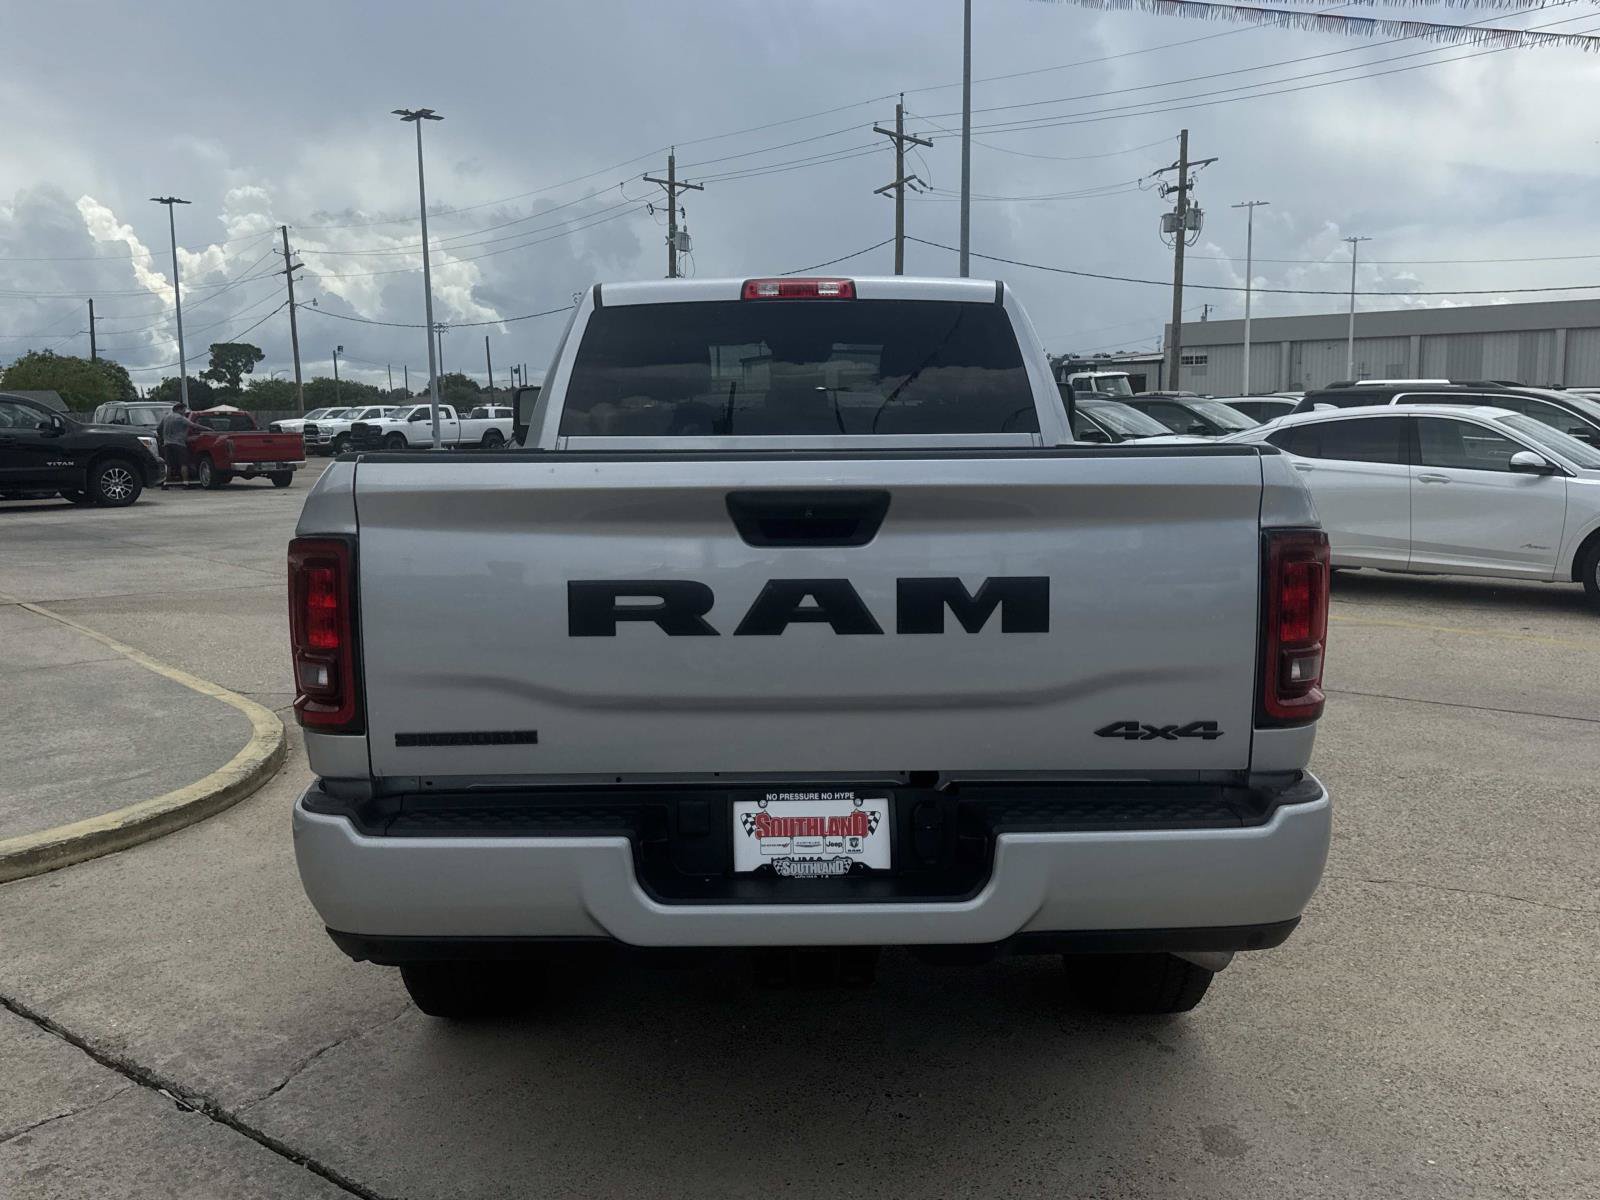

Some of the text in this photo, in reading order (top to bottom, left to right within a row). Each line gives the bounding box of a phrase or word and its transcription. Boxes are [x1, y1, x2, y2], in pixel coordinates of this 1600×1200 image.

[568, 576, 1050, 637] RAM
[1094, 720, 1224, 740] 4x4
[766, 793, 778, 801] NO
[821, 792, 833, 800] NO
